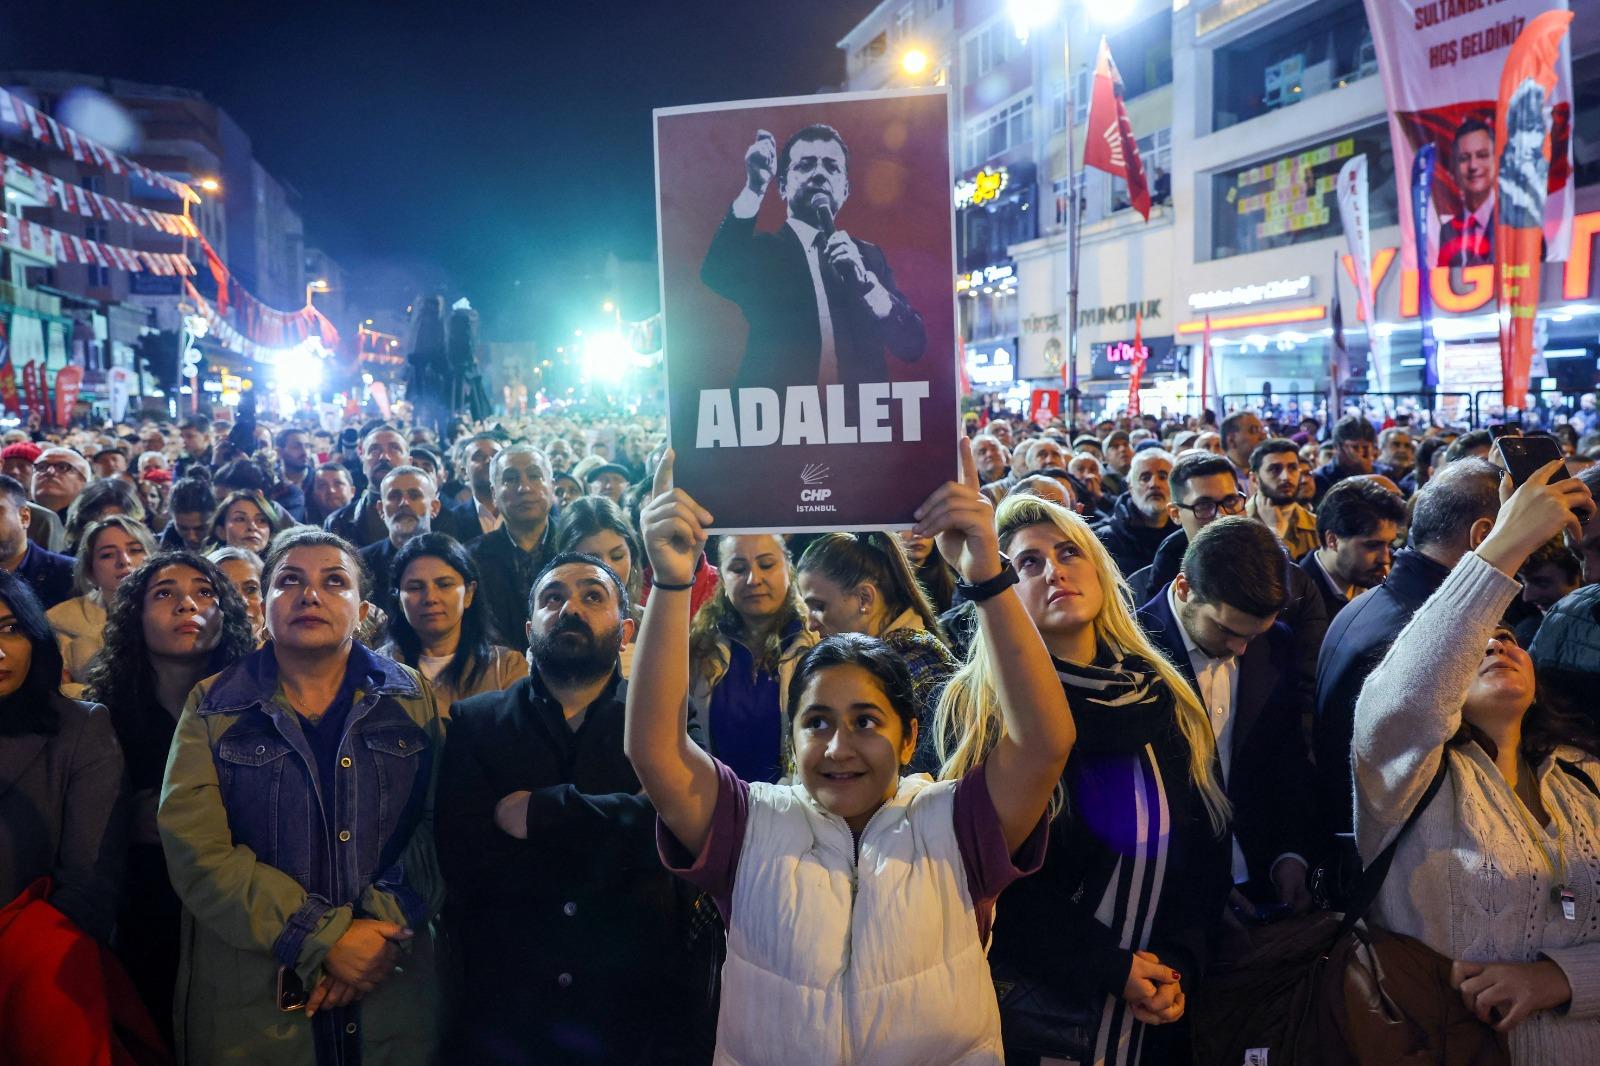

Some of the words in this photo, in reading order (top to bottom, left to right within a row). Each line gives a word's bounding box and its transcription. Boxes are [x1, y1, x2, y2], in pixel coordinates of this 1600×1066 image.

[1429, 40, 1458, 69] HOŞ
[696, 381, 929, 448] ADALET
[801, 489, 832, 501] CHP
[796, 504, 837, 513] İSTANBUL
